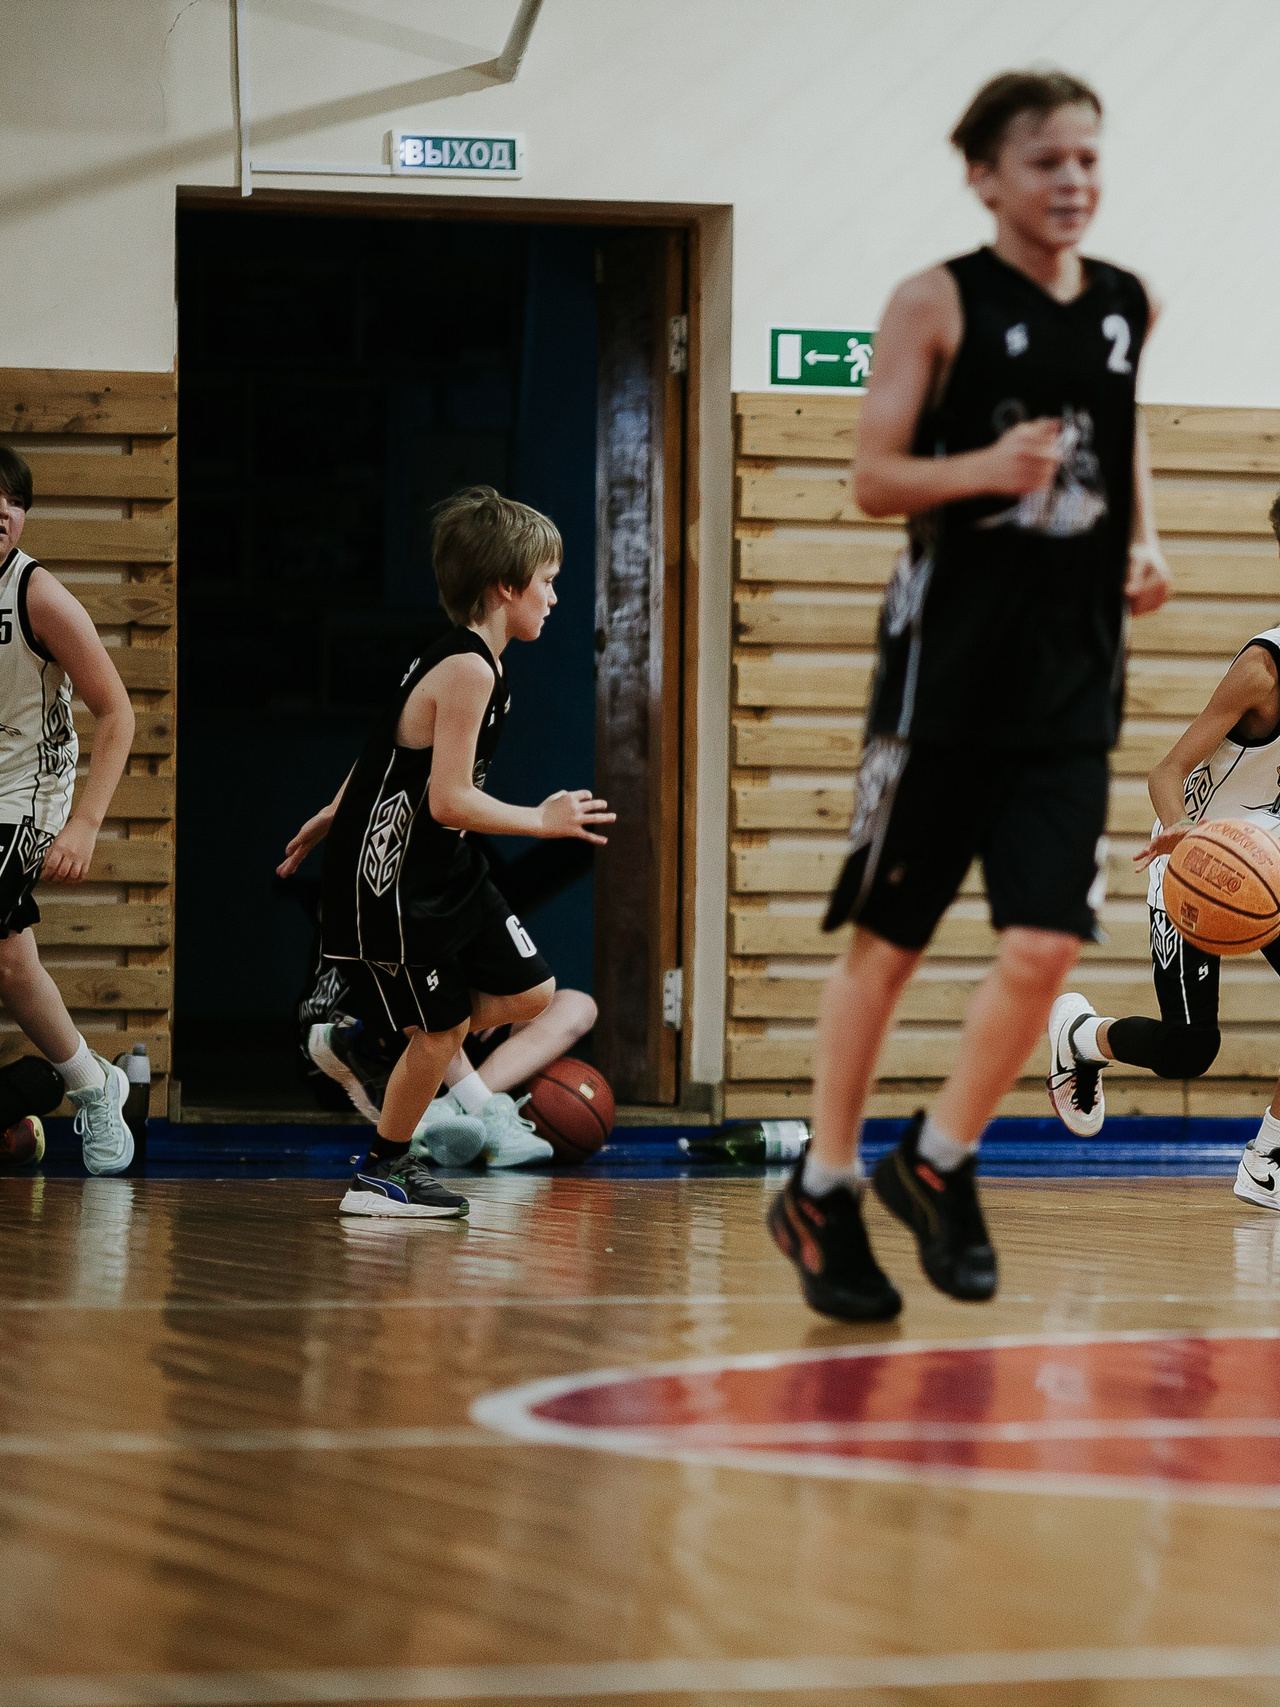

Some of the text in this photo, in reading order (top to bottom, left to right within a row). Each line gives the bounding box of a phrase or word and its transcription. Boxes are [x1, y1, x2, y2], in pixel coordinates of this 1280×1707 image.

[404, 139, 512, 169] ВЫХОД
[1102, 314, 1132, 374] 2
[505, 914, 538, 958] 6
